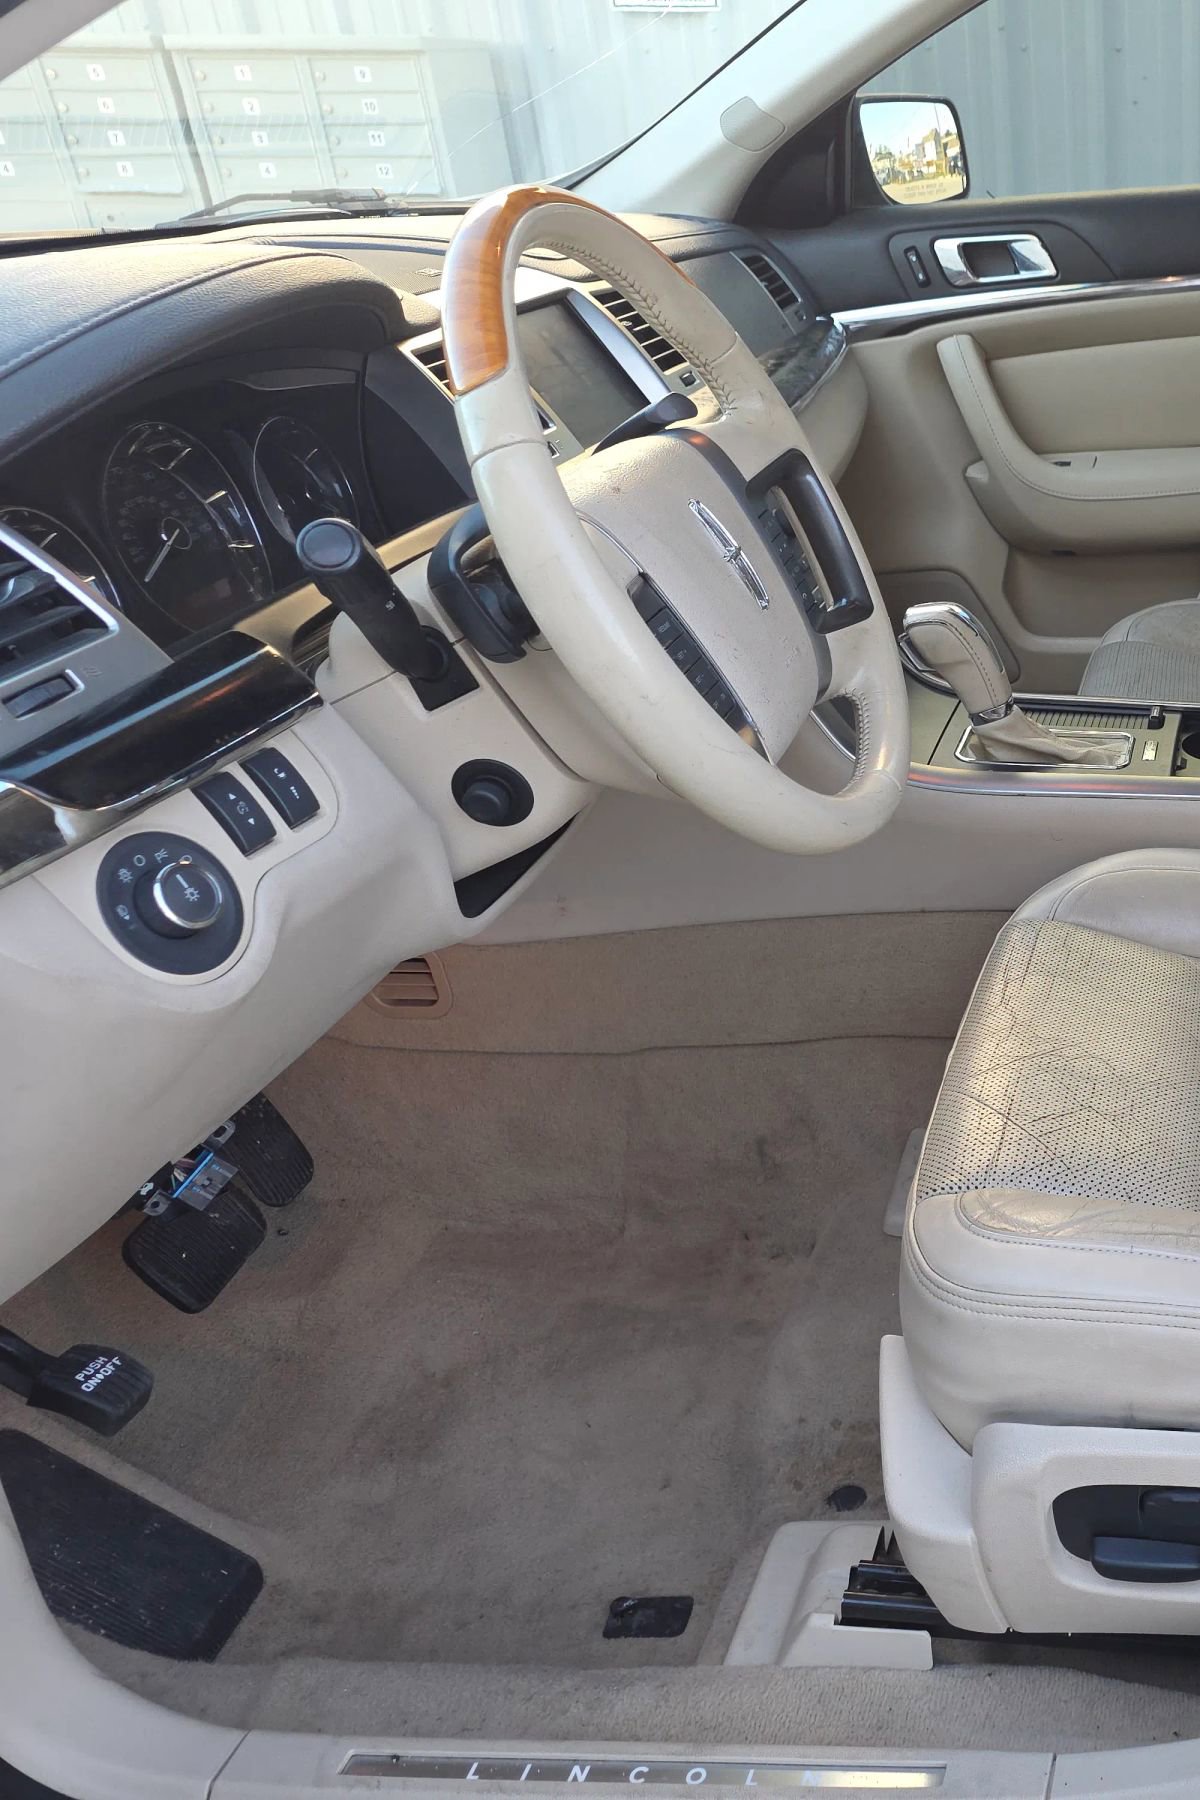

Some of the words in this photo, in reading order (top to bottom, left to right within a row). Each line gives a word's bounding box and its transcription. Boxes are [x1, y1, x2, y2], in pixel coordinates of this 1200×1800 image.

[358, 69, 366, 80] 9
[247, 101, 255, 113] 2
[363, 101, 376, 112] 10
[112, 132, 119, 144] 7
[256, 134, 264, 144] 3
[371, 133, 383, 144] 11
[3, 163, 10, 174] 4
[378, 166, 390, 177] 12
[74, 1356, 109, 1381] PUSH
[465, 1761, 822, 1786] LINCOLN
